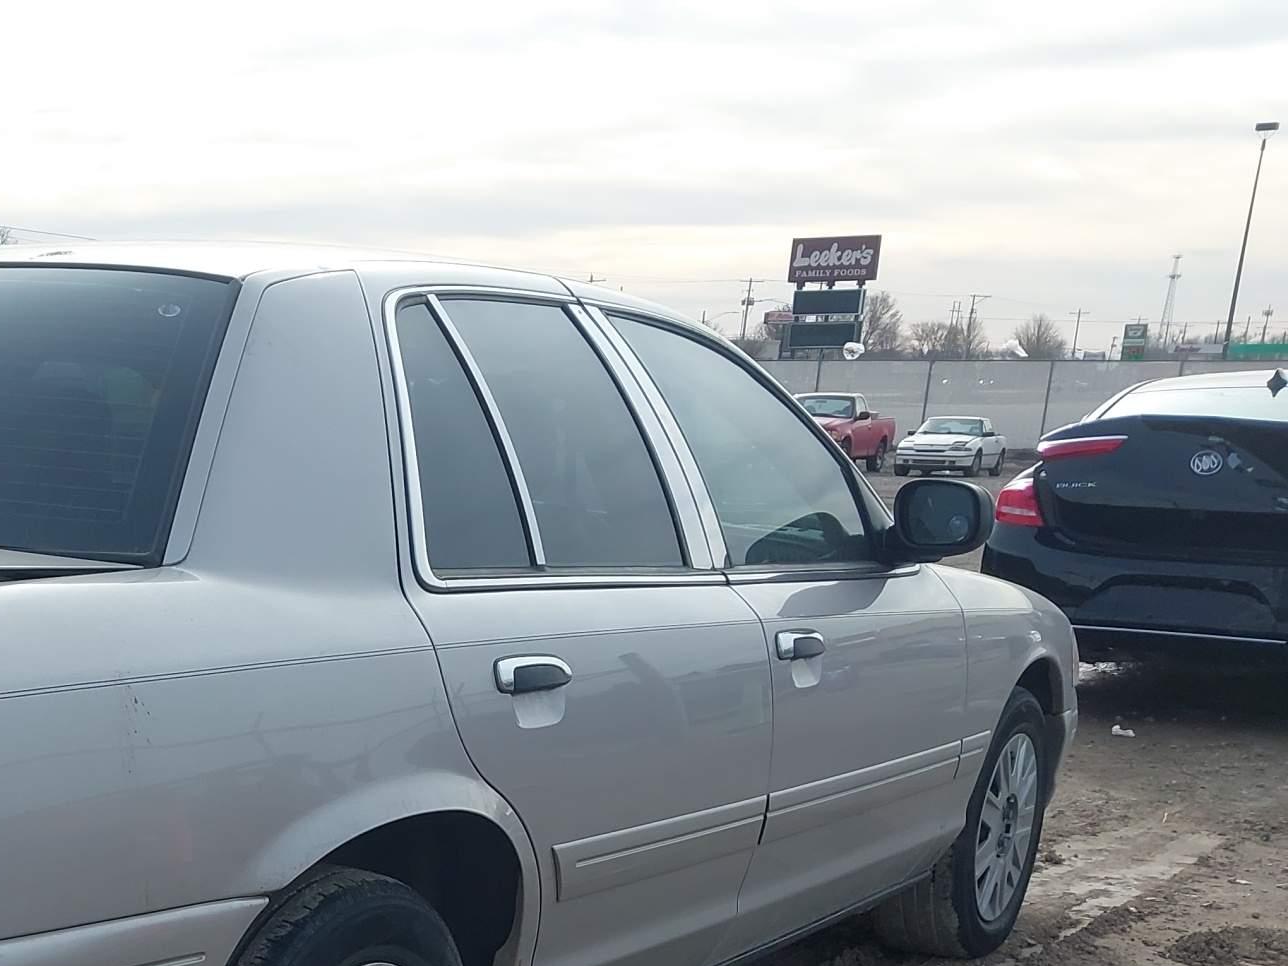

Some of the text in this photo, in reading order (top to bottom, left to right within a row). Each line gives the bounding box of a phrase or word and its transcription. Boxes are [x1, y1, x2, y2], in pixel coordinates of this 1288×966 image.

[793, 243, 874, 267] Leeker's
[795, 268, 867, 278] FAMILY FOODS
[1056, 481, 1097, 489] BUICK
